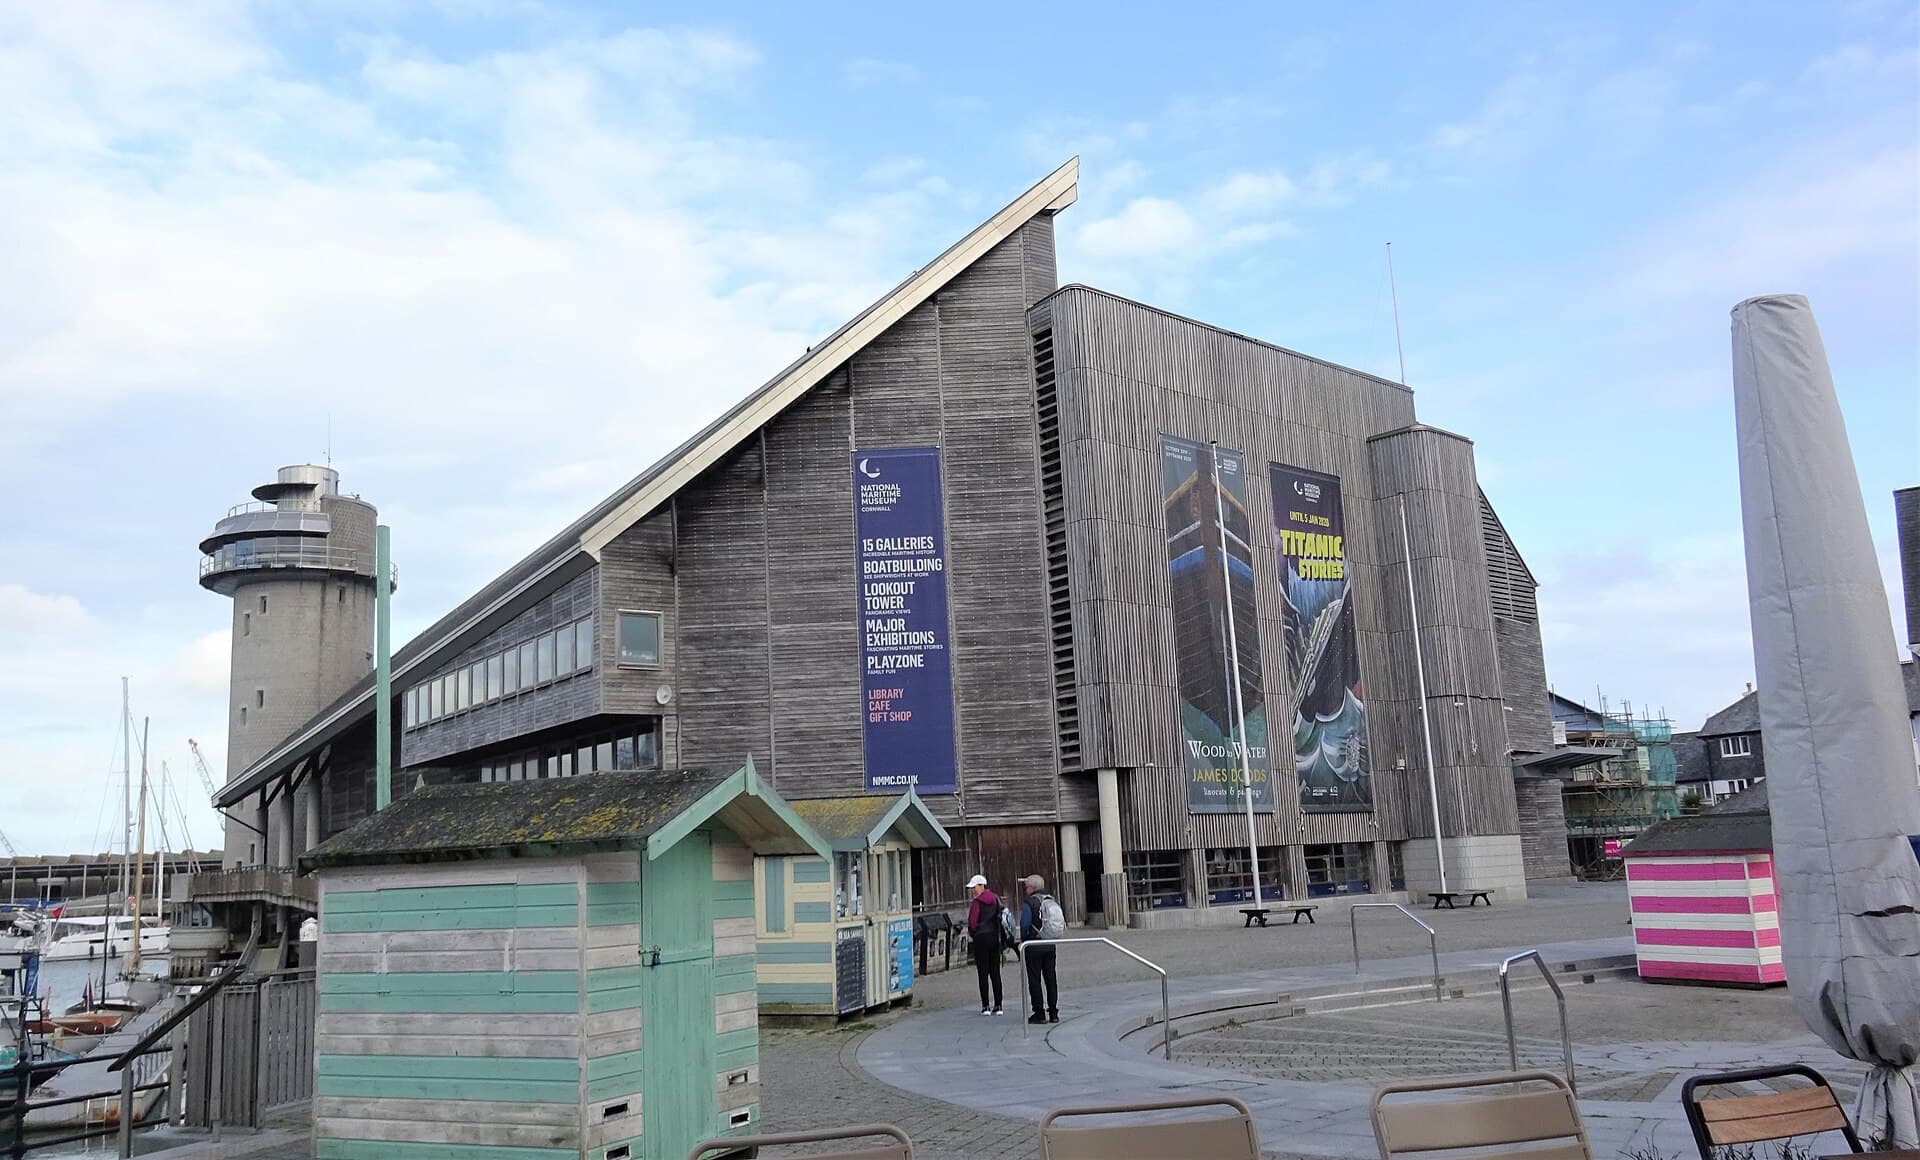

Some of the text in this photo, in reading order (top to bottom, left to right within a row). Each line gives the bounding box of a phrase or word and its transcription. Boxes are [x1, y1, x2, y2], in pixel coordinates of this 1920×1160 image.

[1290, 511, 1304, 522] UNTIL
[862, 536, 934, 551] 15 GALLERIES
[1280, 529, 1343, 558] TITANIC
[864, 558, 942, 574] BOATBUILDING
[1299, 559, 1344, 579] STORIES
[864, 582, 915, 596] LOOKOUT
[865, 596, 904, 610] TOWER
[866, 619, 905, 632] MAJOR
[866, 631, 935, 646] EXHIBITIONS
[868, 654, 924, 669] PLAYZONE
[868, 688, 904, 699] LIBRARY
[869, 700, 890, 711] CAFE
[870, 711, 912, 722] GIFT SHOP
[1188, 740, 1226, 759] WOOD
[872, 775, 918, 786] NMMC.CO.UK
[1192, 768, 1228, 782] JAMES
